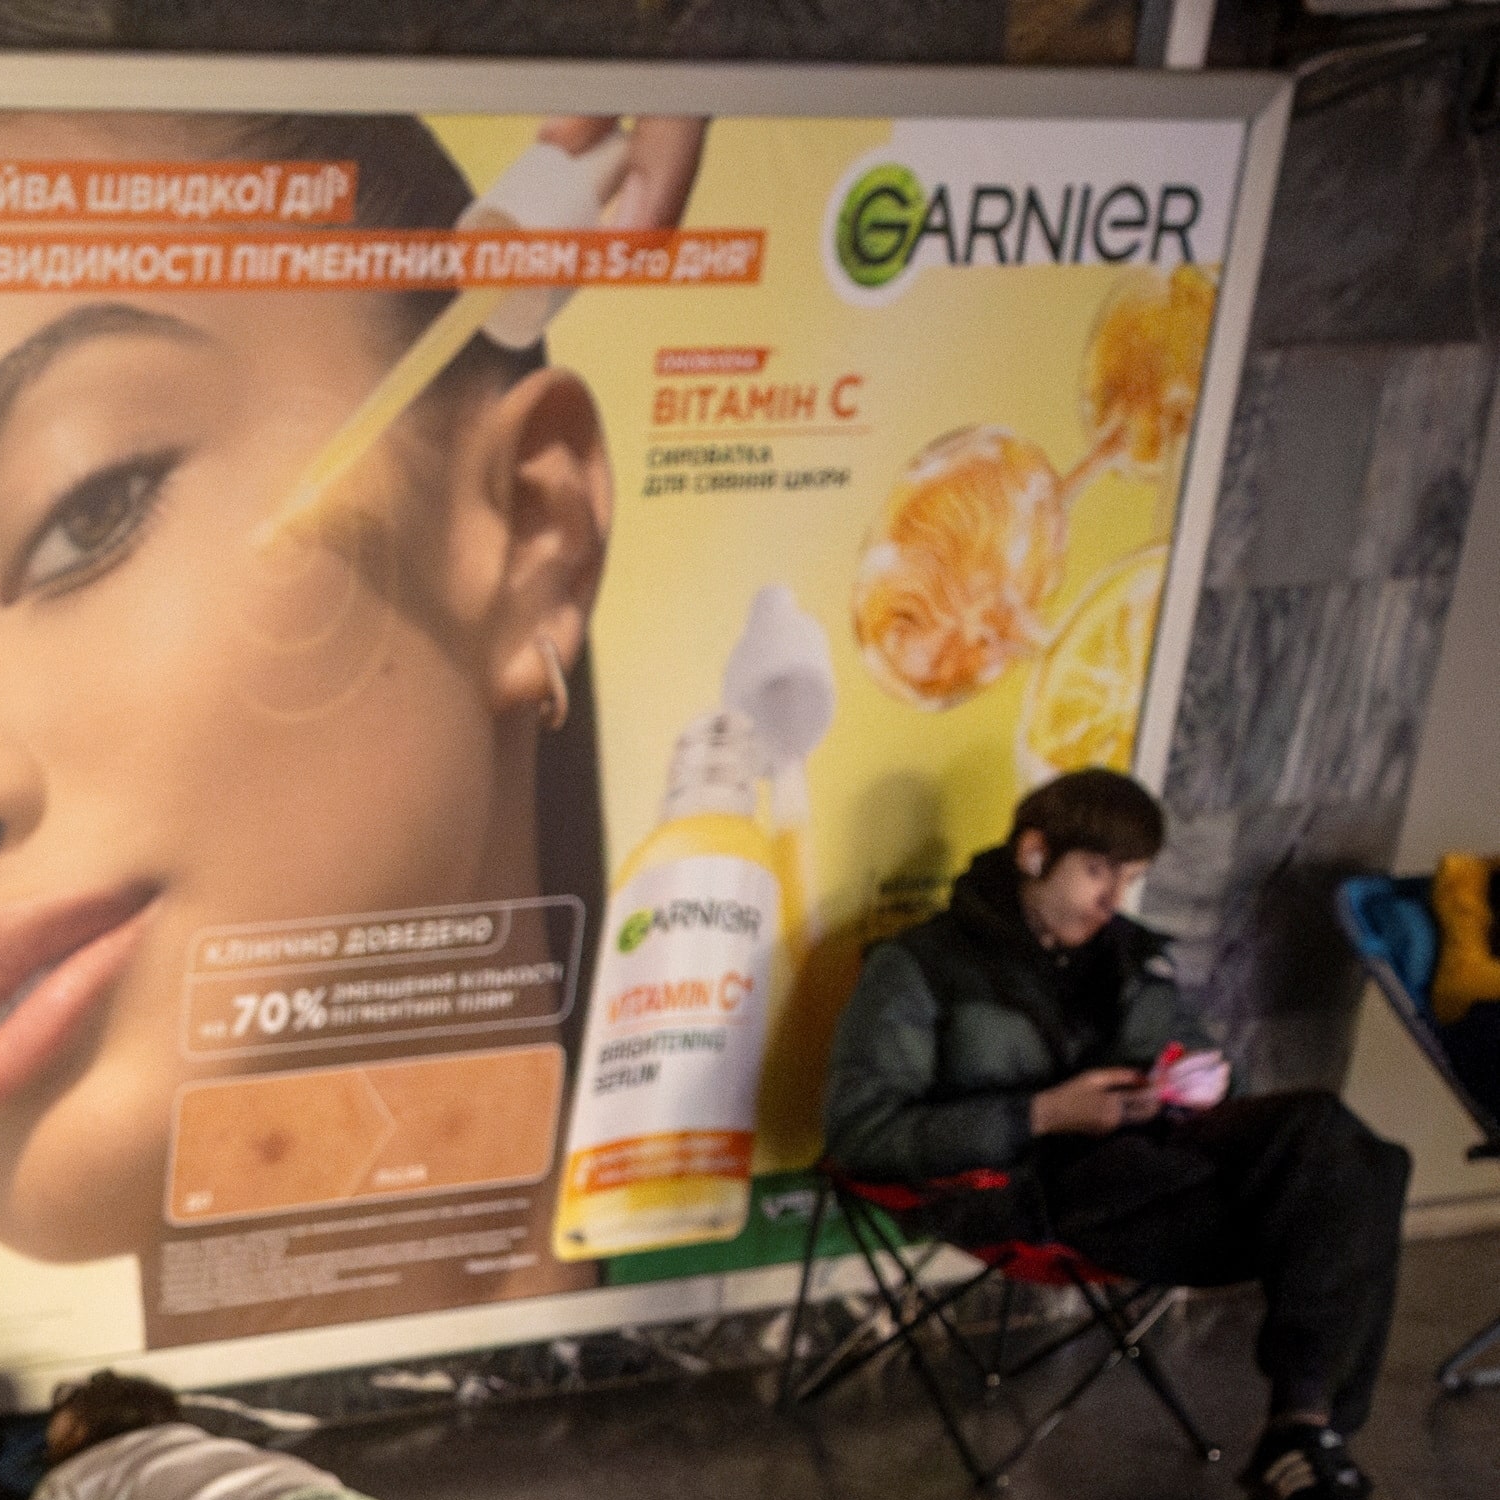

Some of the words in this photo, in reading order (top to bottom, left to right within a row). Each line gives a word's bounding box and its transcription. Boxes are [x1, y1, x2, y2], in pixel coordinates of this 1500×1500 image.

[87, 167, 281, 217] ШВИДКОЇ
[851, 183, 1200, 266] GARNIER
[231, 242, 466, 281] ПІГМЕНТНИХ
[474, 241, 578, 279] ПЛЯМ
[653, 386, 818, 425] ВІТАМІН
[345, 916, 492, 955] ДОВЕДЕНО
[231, 988, 327, 1037] 70%
